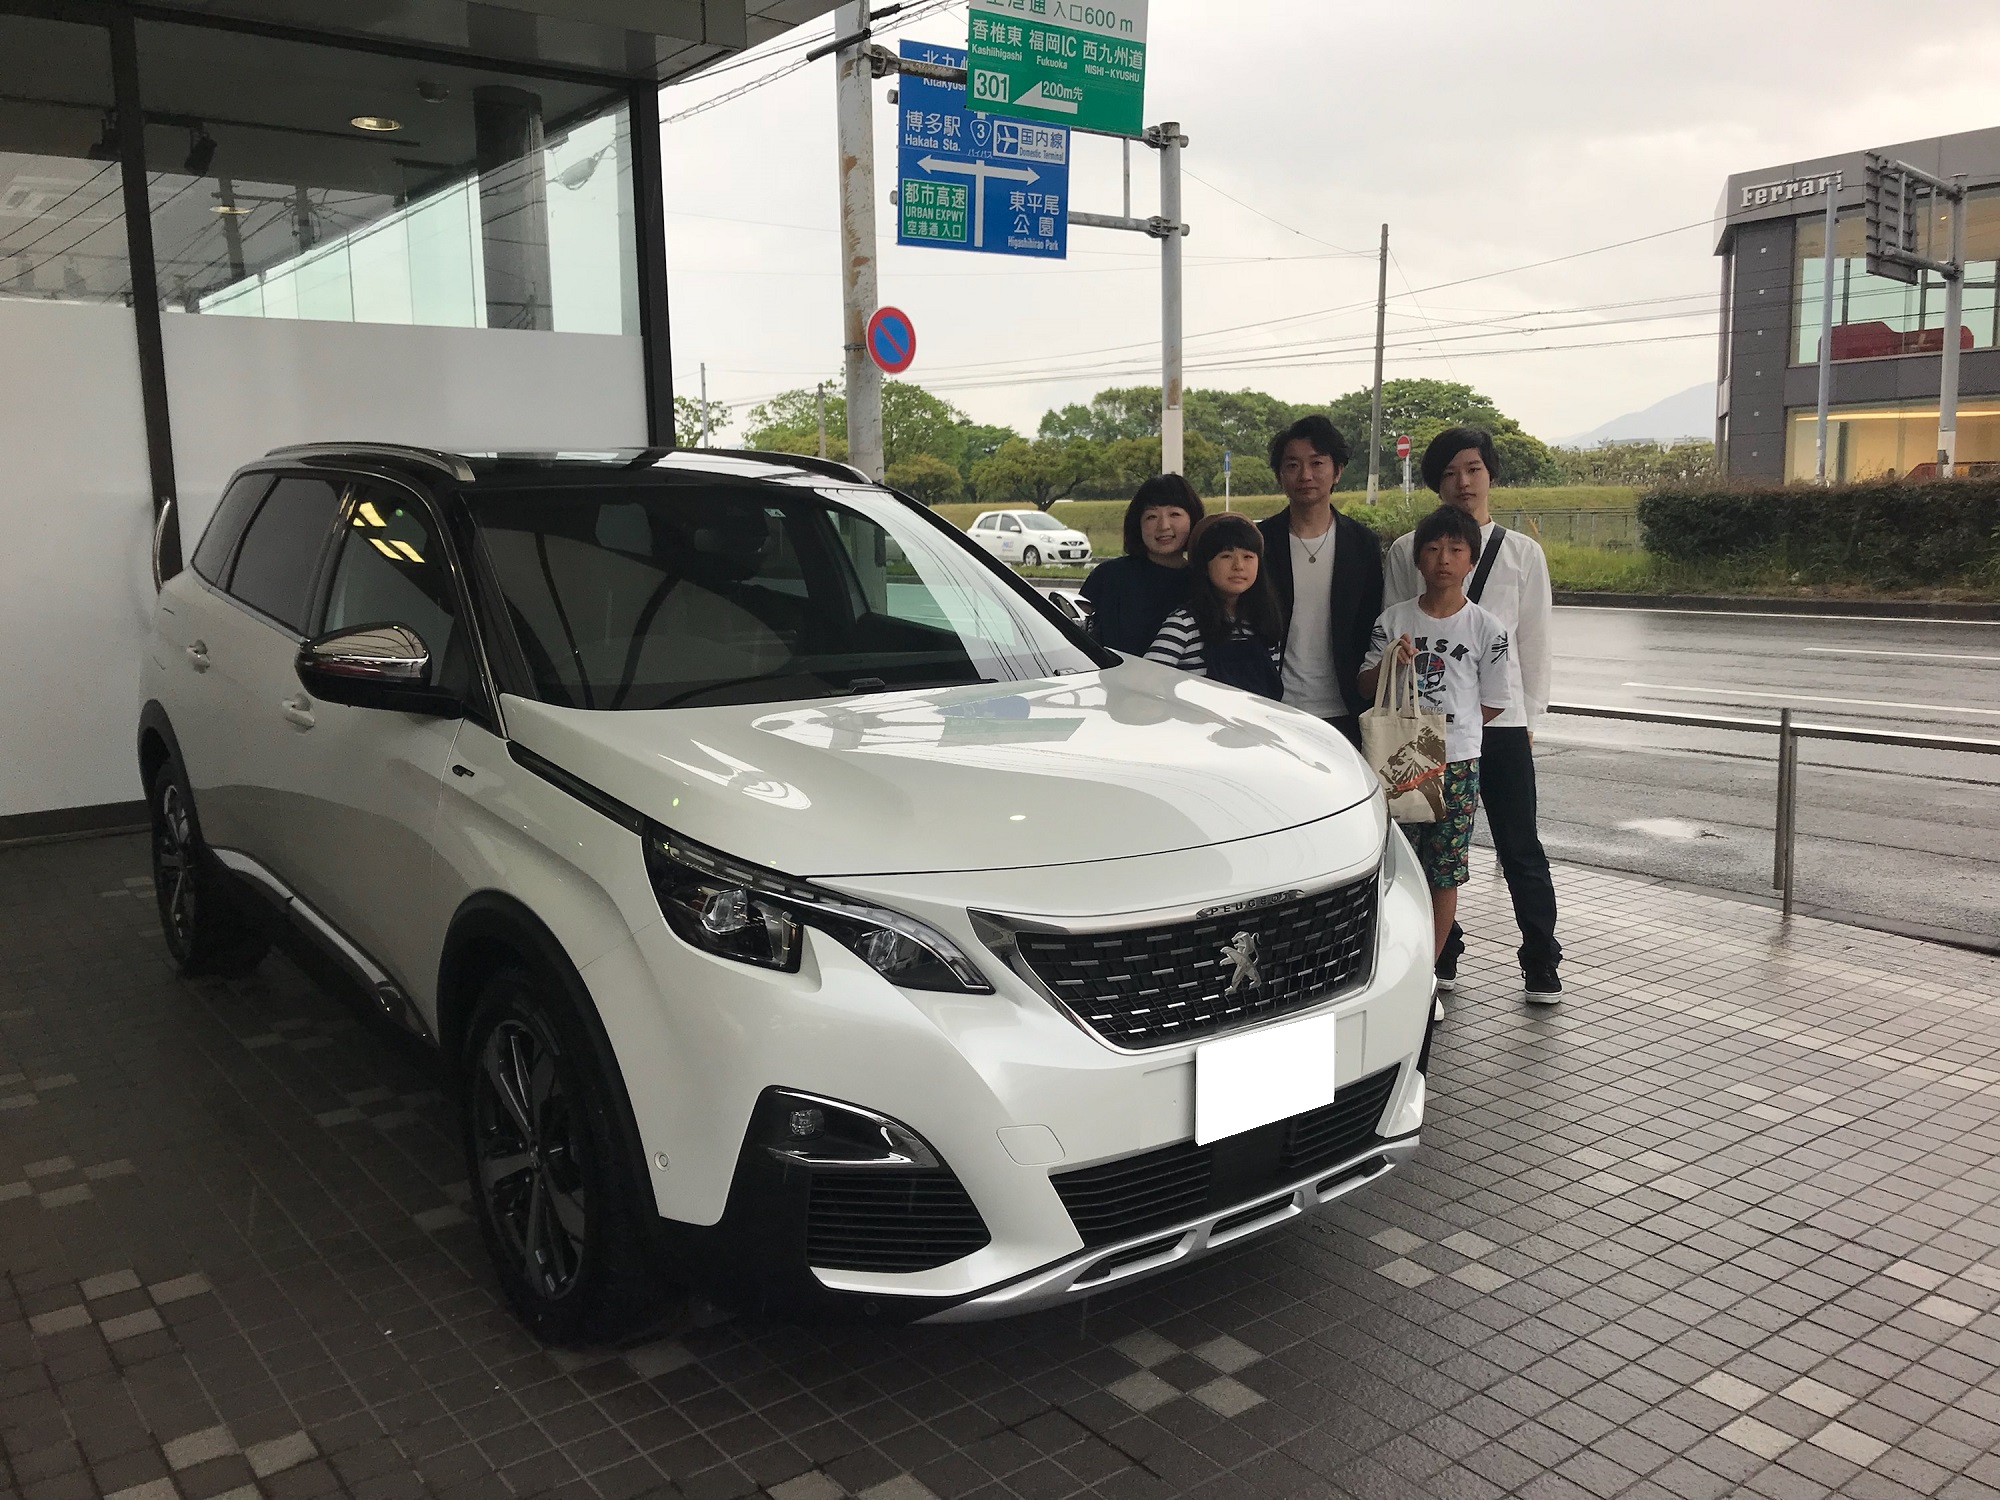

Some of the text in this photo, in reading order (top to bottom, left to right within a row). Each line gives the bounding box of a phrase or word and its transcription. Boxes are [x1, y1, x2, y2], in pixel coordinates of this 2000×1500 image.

[971, 43, 1023, 62] Kashiihigashi
[1036, 55, 1068, 70] Fukuoka
[972, 18, 1023, 48] 香椎東
[1082, 39, 1143, 70] 西九州道
[976, 72, 1009, 101] 301
[906, 110, 961, 138] 博多駅
[977, 124, 985, 139] 3
[905, 133, 961, 152] Hakata Sta.
[1022, 128, 1063, 150] 国内線
[1020, 147, 1063, 161] Domestic Terminal
[905, 182, 965, 209] 都市高速
[1740, 169, 1843, 208] Ferrari
[905, 206, 964, 223] URBAN EXPWY
[1009, 190, 1060, 216] 東平尾
[1045, 237, 1059, 251] Park
[1210, 890, 1289, 916] PEUGEOT
